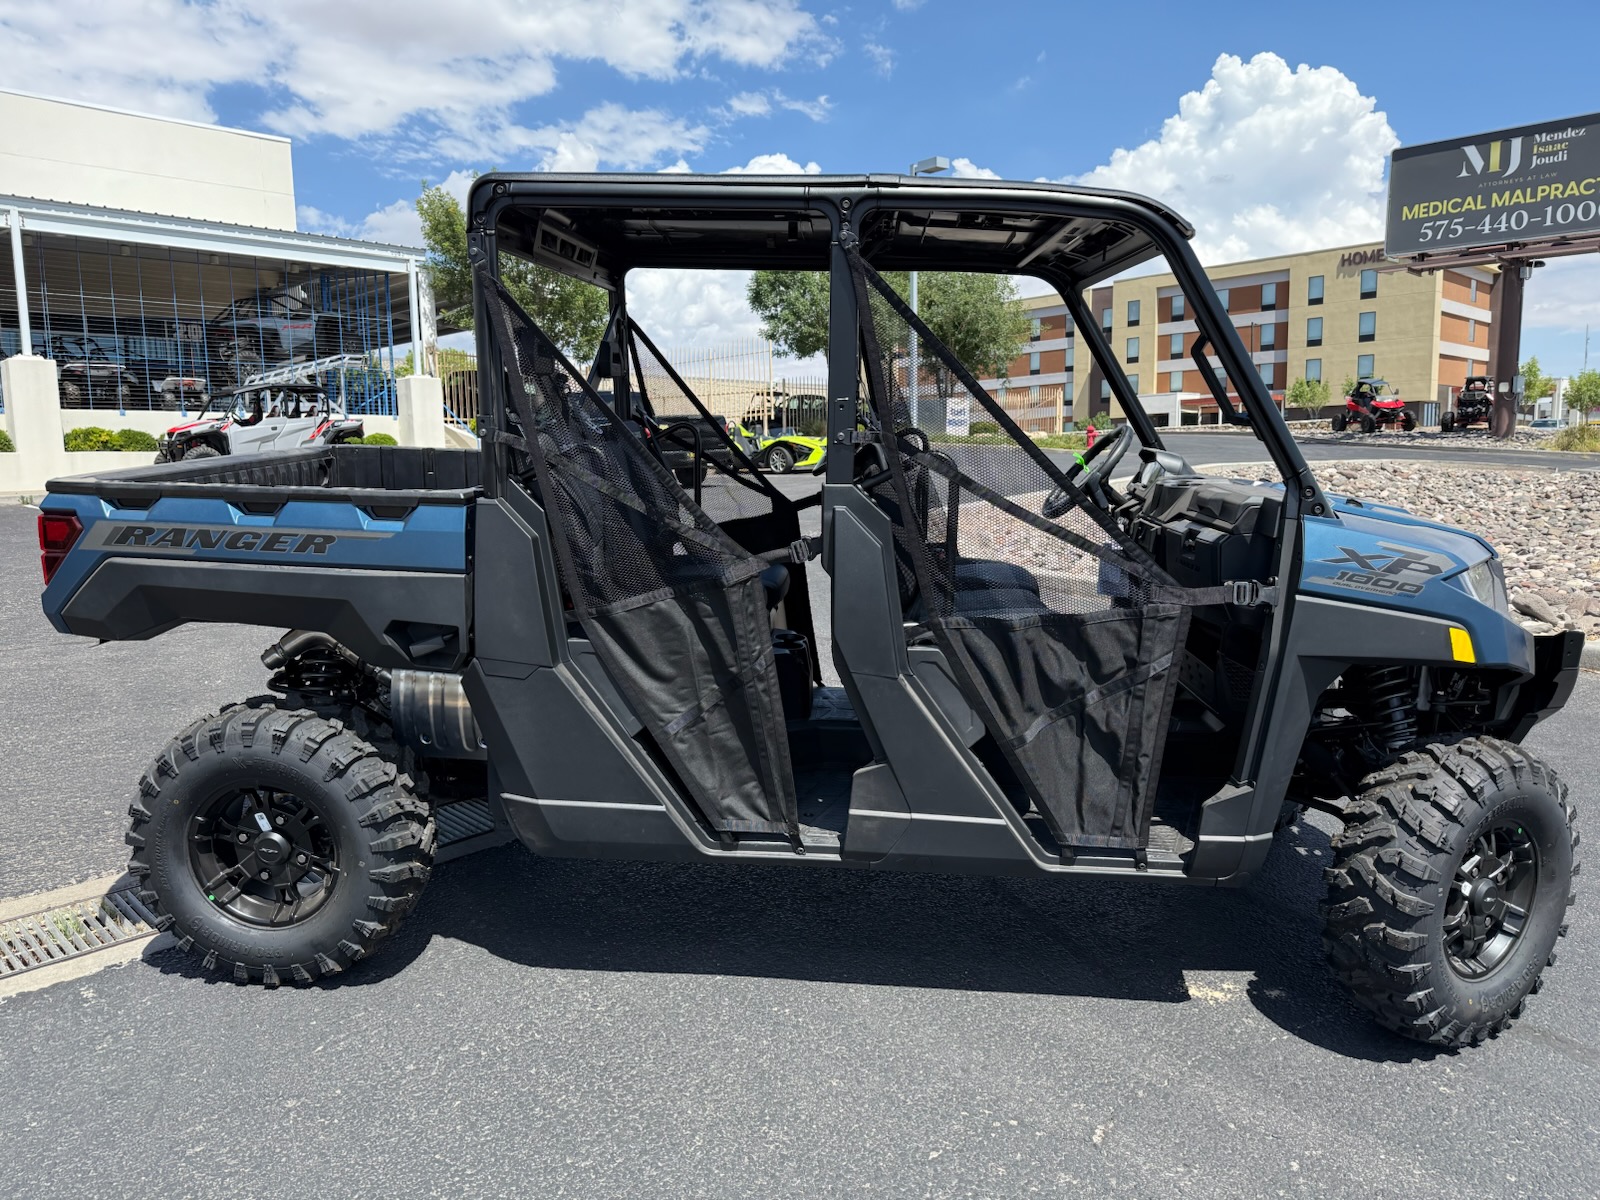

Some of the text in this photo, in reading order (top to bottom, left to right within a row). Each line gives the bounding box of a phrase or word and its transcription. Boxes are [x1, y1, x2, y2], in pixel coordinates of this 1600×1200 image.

[1533, 127, 1586, 144] Mendez
[1533, 141, 1569, 154] Isaac
[1530, 150, 1568, 170] Joudi
[1478, 177, 1524, 188] ATTORNEYS
[1540, 171, 1558, 179] LAW
[1401, 195, 1487, 221] MEDICAL
[1419, 200, 1600, 242] 575-440-100
[1341, 248, 1386, 267] HOME
[113, 525, 338, 555] RANGER
[1321, 546, 1443, 574] XP
[1335, 571, 1424, 593] 1000
